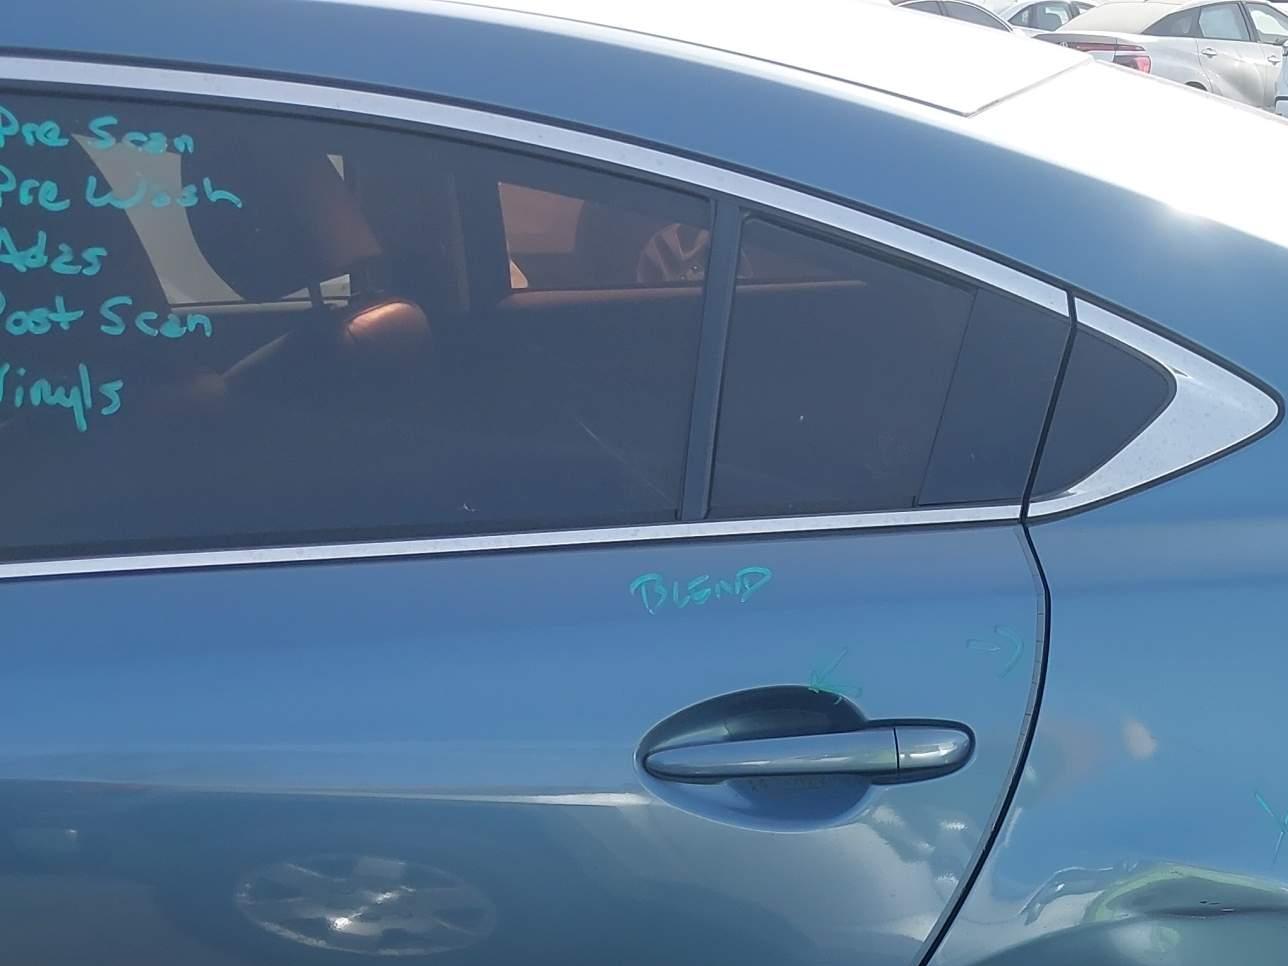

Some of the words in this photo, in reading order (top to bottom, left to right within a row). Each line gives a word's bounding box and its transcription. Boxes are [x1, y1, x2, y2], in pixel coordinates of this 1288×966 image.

[88, 115, 194, 153] Scan
[86, 176, 242, 209] Wash
[100, 296, 212, 337] Scan
